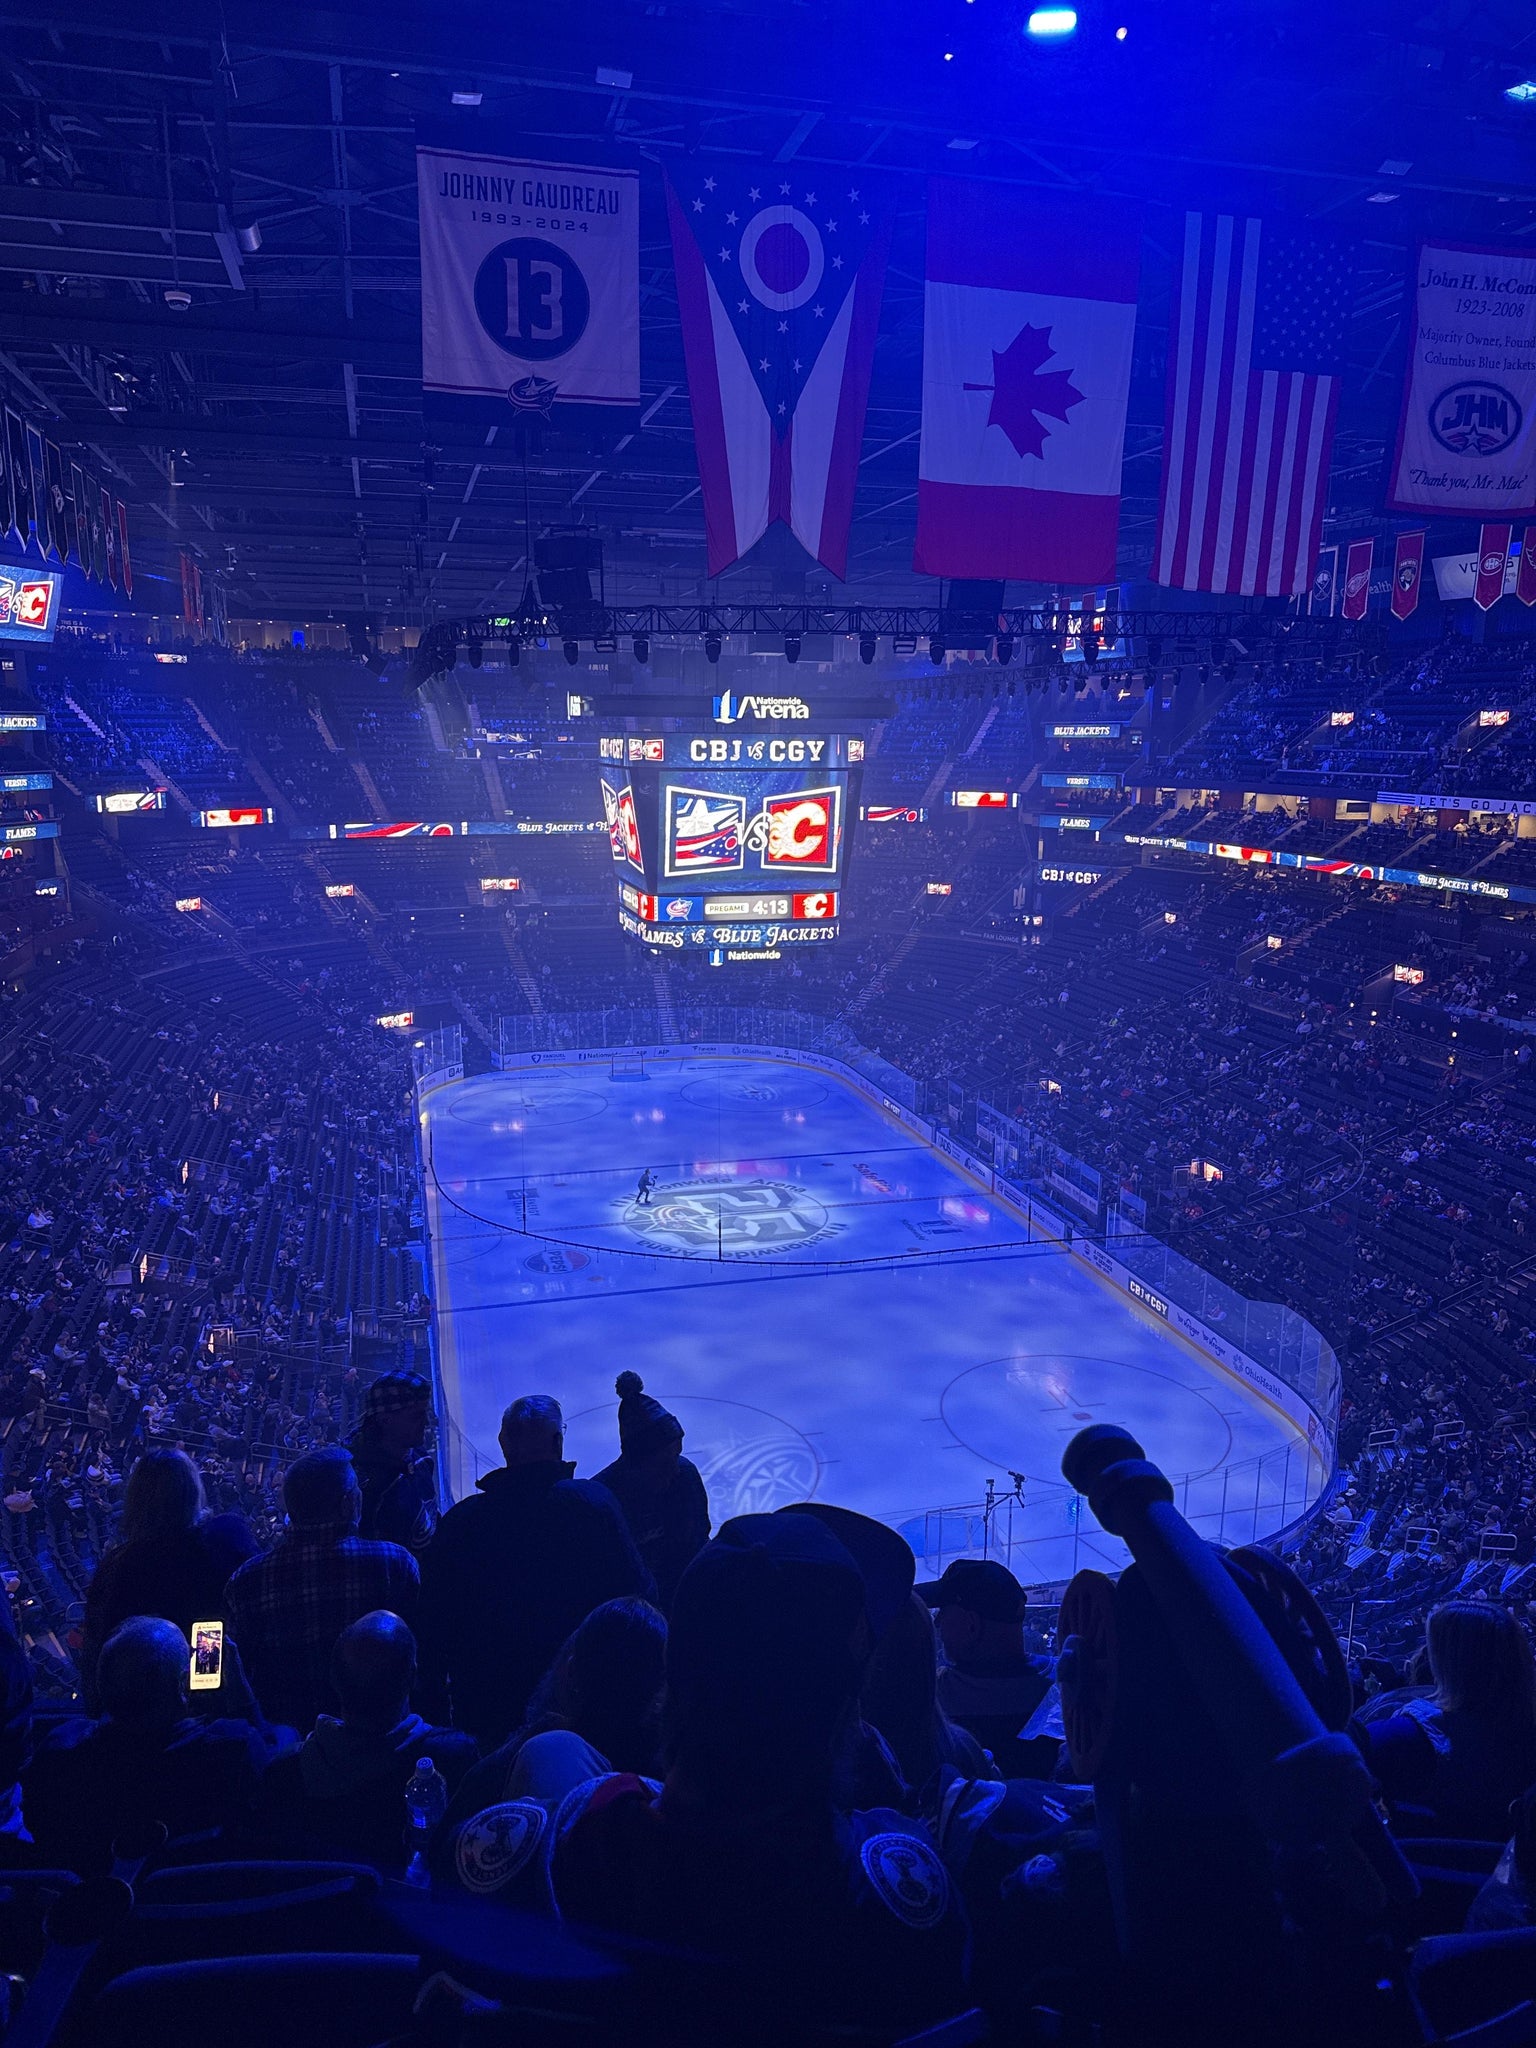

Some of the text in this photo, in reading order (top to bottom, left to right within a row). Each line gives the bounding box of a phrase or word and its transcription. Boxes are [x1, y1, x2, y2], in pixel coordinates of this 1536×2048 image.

[440, 172, 620, 215] JOHNNY GAUDREAU
[472, 211, 589, 232] 1993-2024
[1420, 269, 1458, 289] John
[1461, 274, 1478, 290] H.
[503, 257, 563, 340] 13
[1456, 298, 1525, 318] 1923-2008
[1419, 327, 1464, 346] Majority
[1466, 332, 1502, 349] Owner,
[1424, 351, 1536, 372] Columbus Blue Jackets
[1441, 394, 1508, 437] JHM
[1449, 476, 1470, 493] you,
[1472, 475, 1495, 489] Mr.
[736, 696, 810, 720] Arena
[756, 696, 802, 706] Nationwide
[3, 718, 37, 728] JACKETS
[1054, 726, 1111, 736] BLUE JACKETS
[690, 739, 742, 761] CBJ
[769, 740, 825, 761] CGY
[4, 778, 27, 787] VERSUS
[1067, 777, 1089, 786] VERSUS
[1420, 796, 1460, 808] LET'S
[1472, 800, 1490, 811] GO
[517, 823, 544, 833] BLUE
[545, 823, 584, 835] JACKETS
[1060, 818, 1091, 827] FLAMES
[6, 828, 36, 840] FLAMES
[1042, 869, 1065, 882] CBJ
[1075, 872, 1102, 884] CGY
[1418, 874, 1437, 886] BLUE
[1438, 877, 1469, 890] JACKETS
[1479, 882, 1509, 898] FLAMES
[753, 900, 788, 915] 4:13
[1439, 916, 1458, 925] CLUB
[713, 926, 761, 944] BLUE
[767, 926, 834, 946] JACKETS
[728, 950, 781, 961] Nationwide
[750, 1178, 807, 1194] Arena
[635, 1230, 834, 1260] Nationwide Arena
[547, 1251, 568, 1273] PEPSI
[1130, 1280, 1144, 1299] CBJ
[1151, 1296, 1168, 1315] CGY
[1244, 1366, 1283, 1400] OhioHealth
